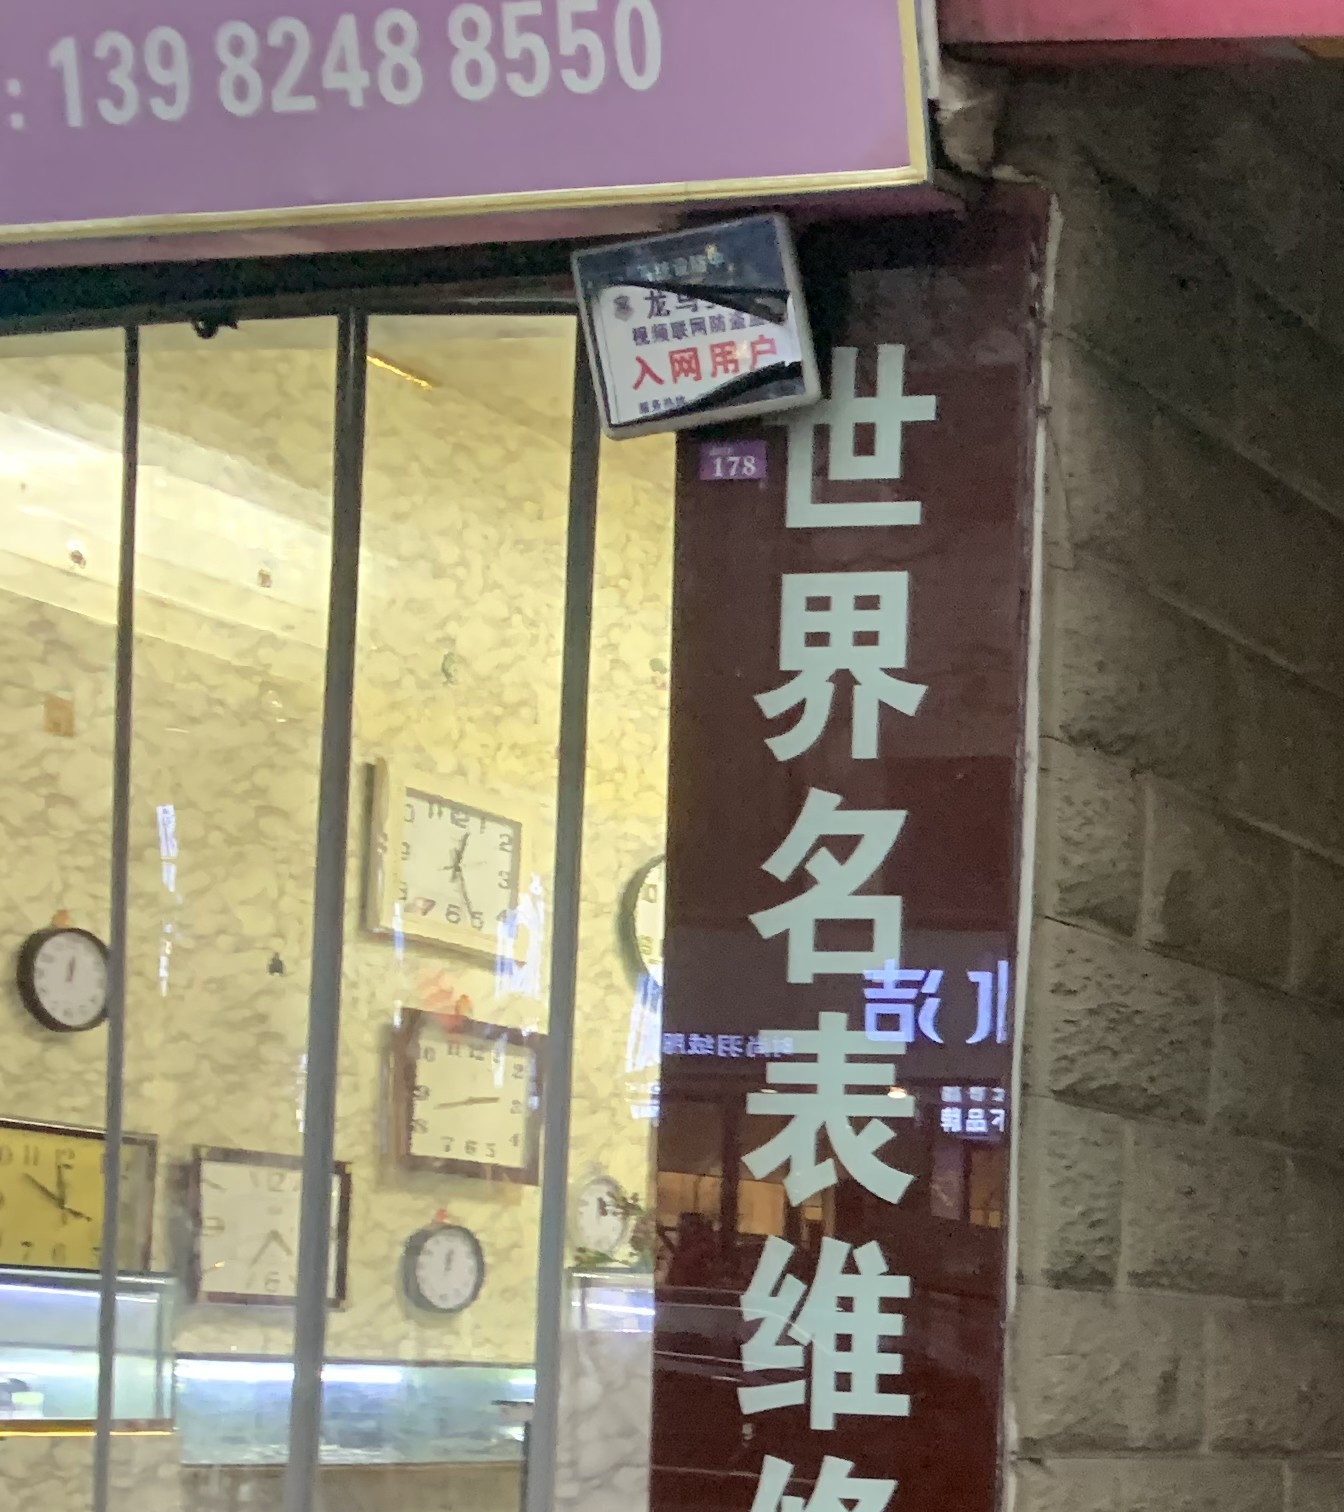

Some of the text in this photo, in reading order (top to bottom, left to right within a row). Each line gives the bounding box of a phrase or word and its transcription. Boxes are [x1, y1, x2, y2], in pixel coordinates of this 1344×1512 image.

[49, 25, 191, 128] 139
[215, 8, 423, 118] 8248
[448, 0, 662, 101] 8550
[632, 334, 778, 391] 入网用户
[712, 455, 757, 478] 178
